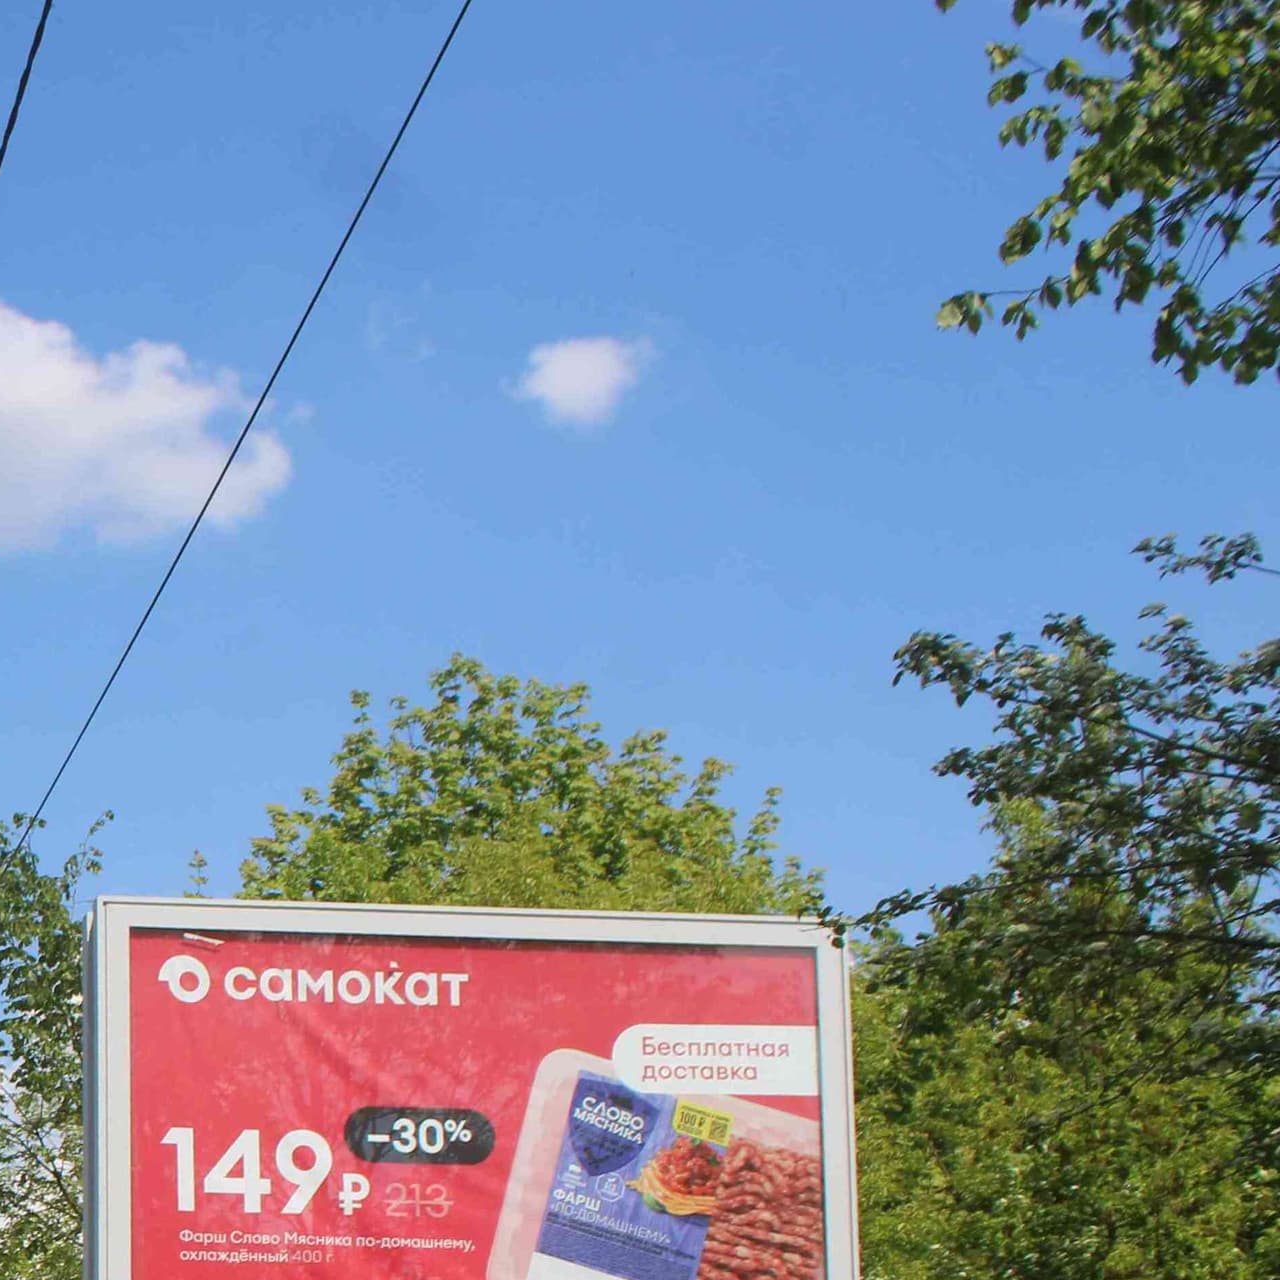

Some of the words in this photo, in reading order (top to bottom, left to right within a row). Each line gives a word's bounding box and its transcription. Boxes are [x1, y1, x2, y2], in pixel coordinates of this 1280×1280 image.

[224, 962, 469, 1006] самокат
[641, 1036, 790, 1057] Бесплатная
[642, 1064, 758, 1082] доставка
[582, 1097, 644, 1129] СЛОВО
[573, 1108, 643, 1144] МЯСНИКА
[384, 1183, 454, 1218] 213
[552, 1188, 601, 1211] ФАРШ
[179, 1230, 226, 1246] Фарш
[230, 1231, 281, 1244] Слово
[284, 1232, 352, 1247] Мясника
[356, 1235, 476, 1252] по-домашнему,
[180, 1249, 289, 1263] охлаждённый
[292, 1250, 322, 1263] 400
